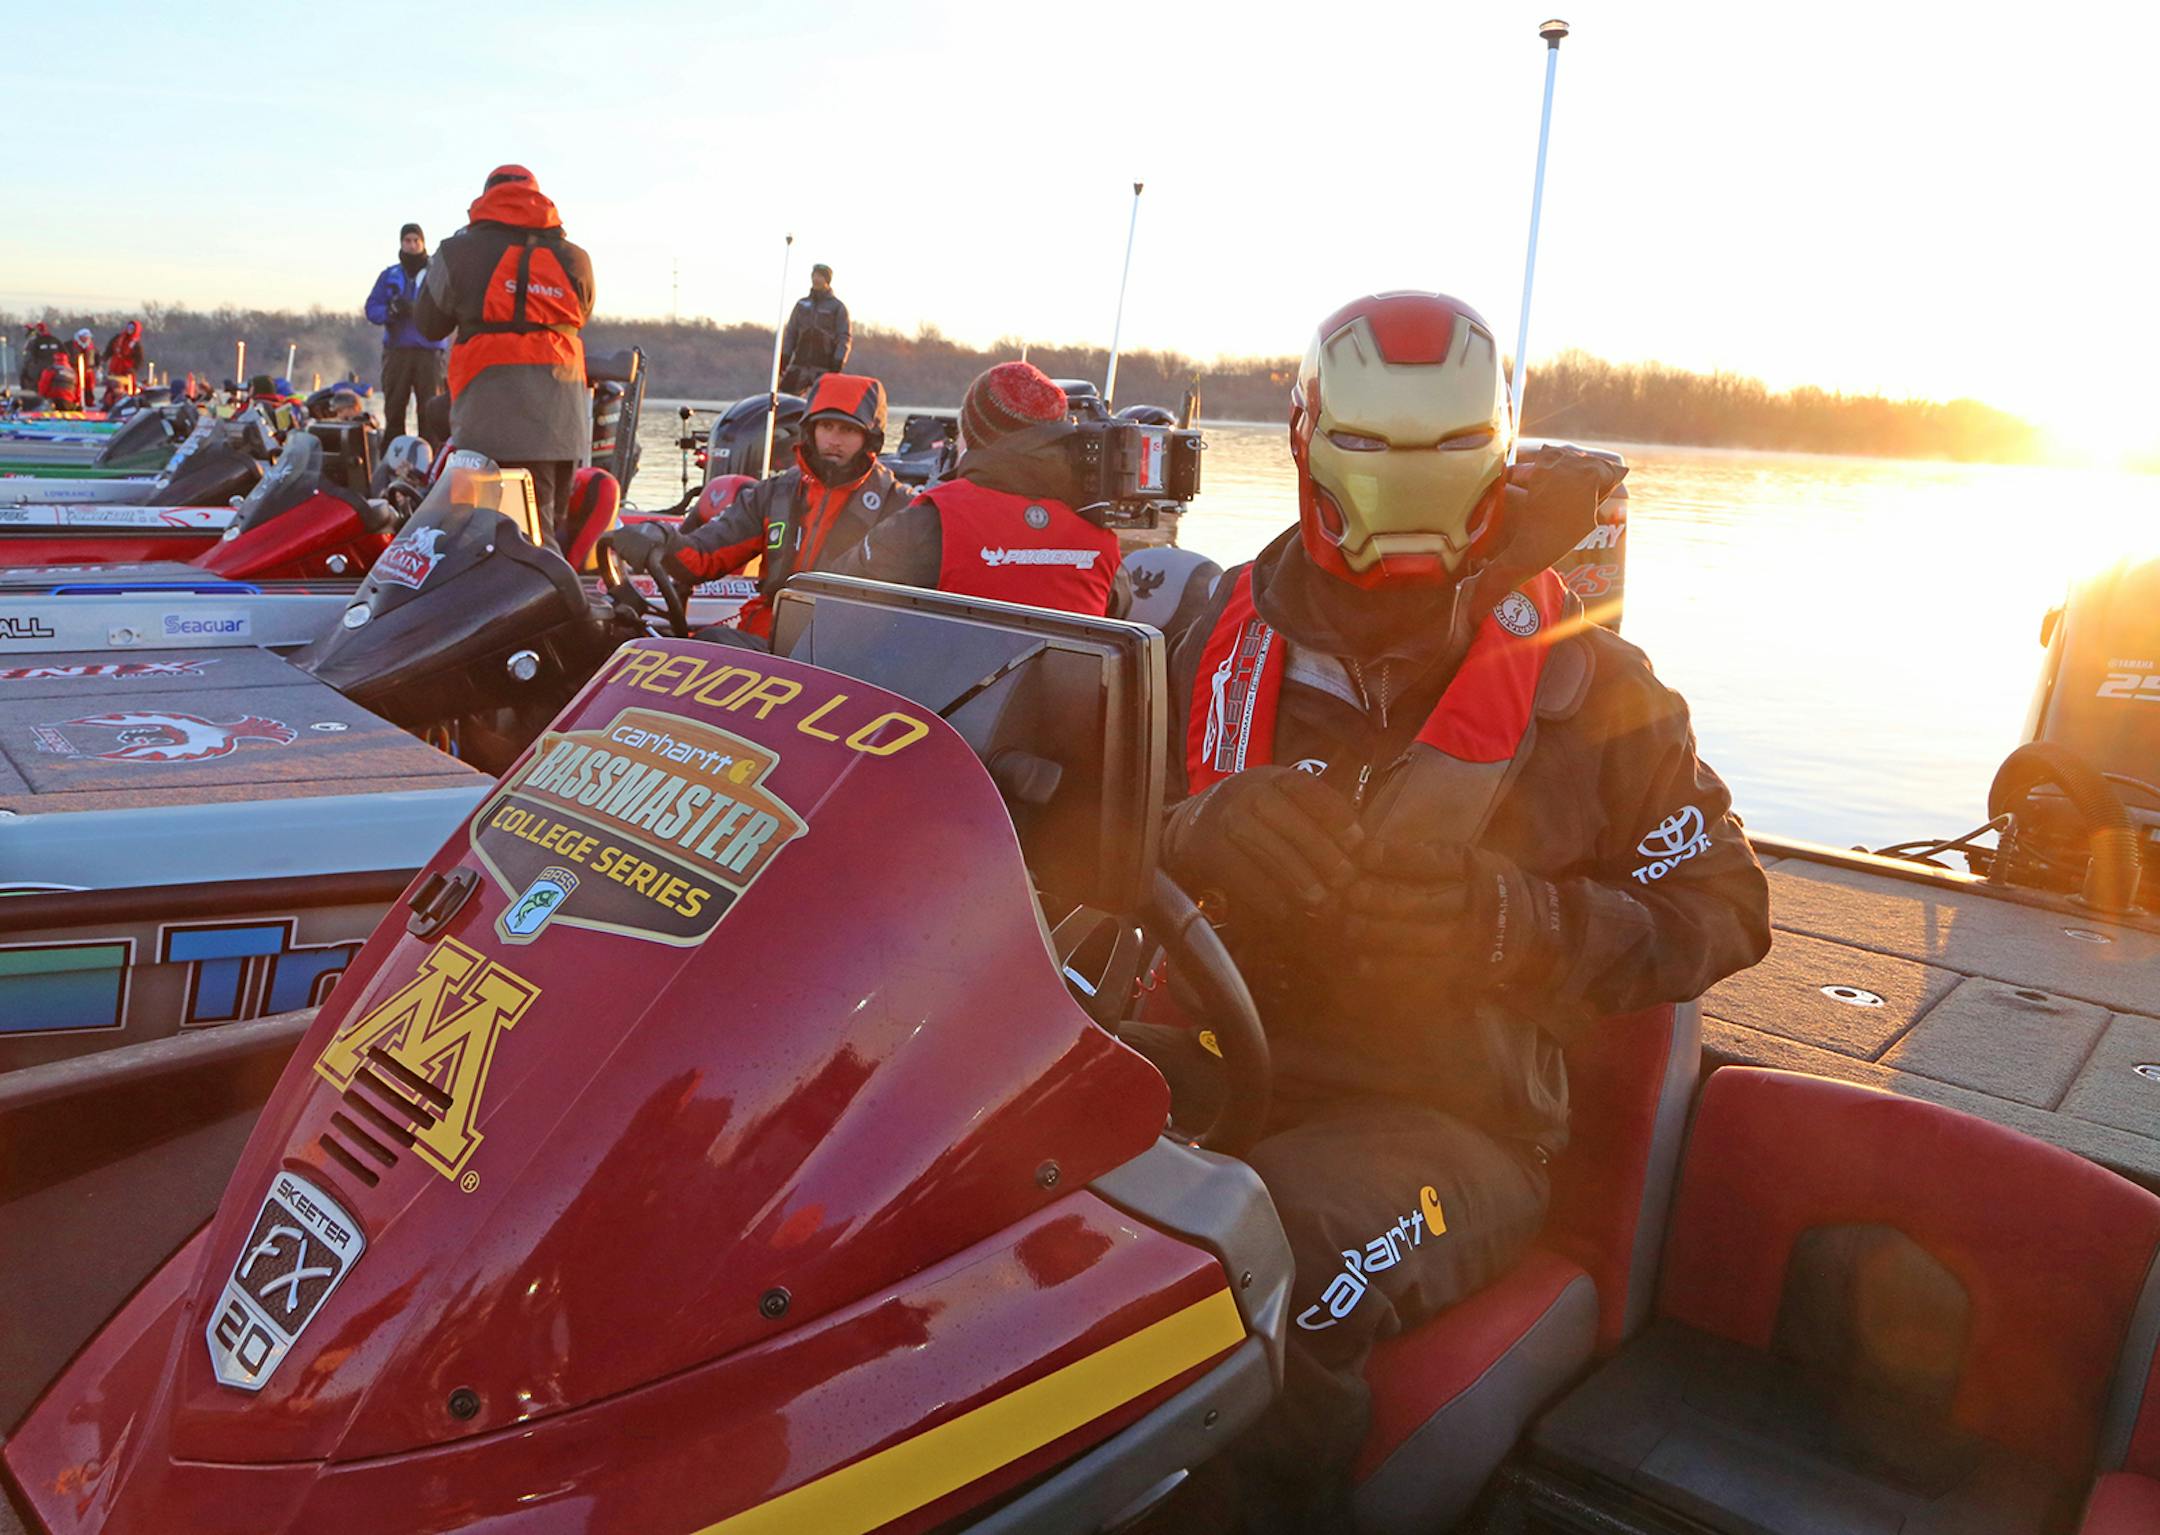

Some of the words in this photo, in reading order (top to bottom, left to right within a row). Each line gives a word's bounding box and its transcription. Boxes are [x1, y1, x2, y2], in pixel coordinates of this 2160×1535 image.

[505, 279, 565, 298] SMMS
[590, 647, 802, 721] TREVOR
[796, 693, 931, 757] LO
[1216, 618, 1266, 773] SKEETER
[611, 723, 733, 776] carhartt
[524, 740, 782, 875] BASSMASTER
[490, 804, 601, 864] COLLEGE
[590, 845, 712, 918] SERIES
[276, 1178, 351, 1251] SKEETER
[240, 1223, 333, 1314] FX
[214, 1299, 276, 1377] 20
